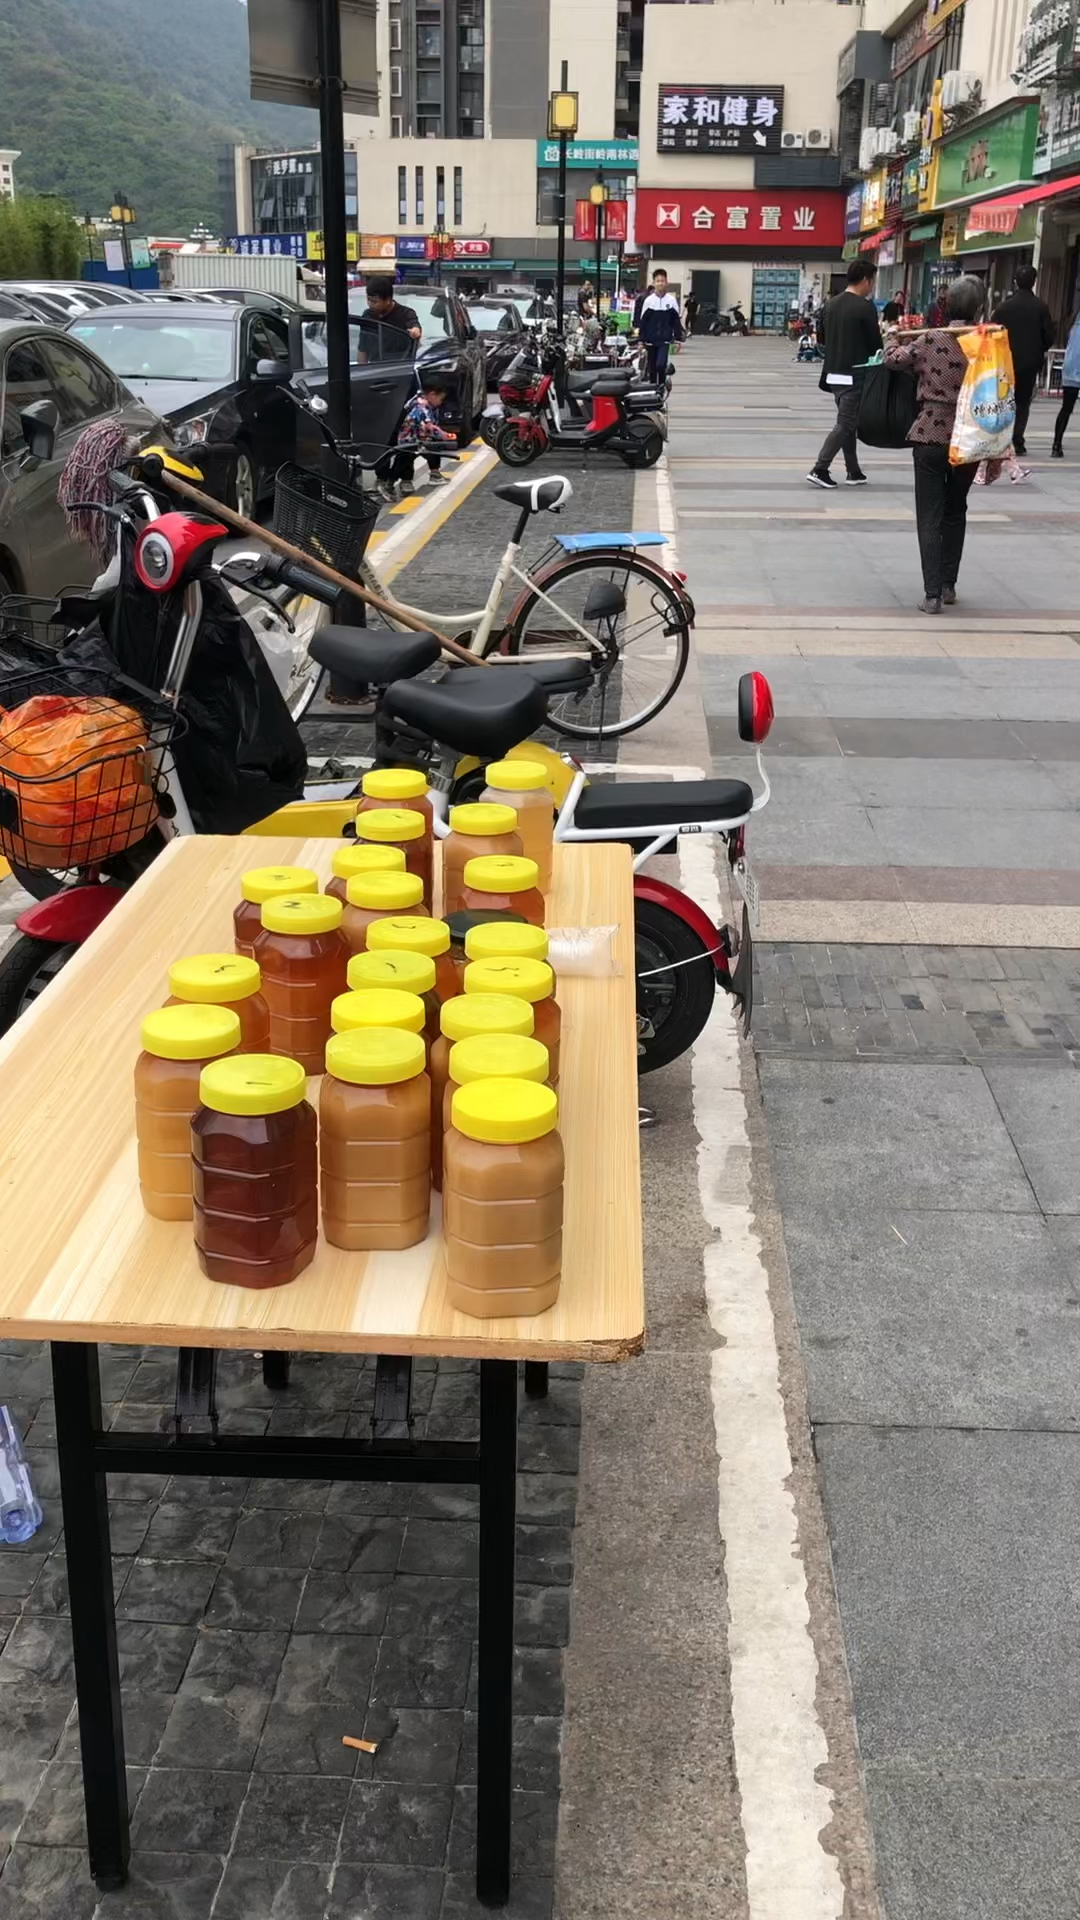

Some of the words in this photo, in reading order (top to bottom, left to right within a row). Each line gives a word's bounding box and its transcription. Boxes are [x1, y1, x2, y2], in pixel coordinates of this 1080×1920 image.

[662, 95, 778, 127] 家和健身
[692, 204, 815, 231] 合富置业
